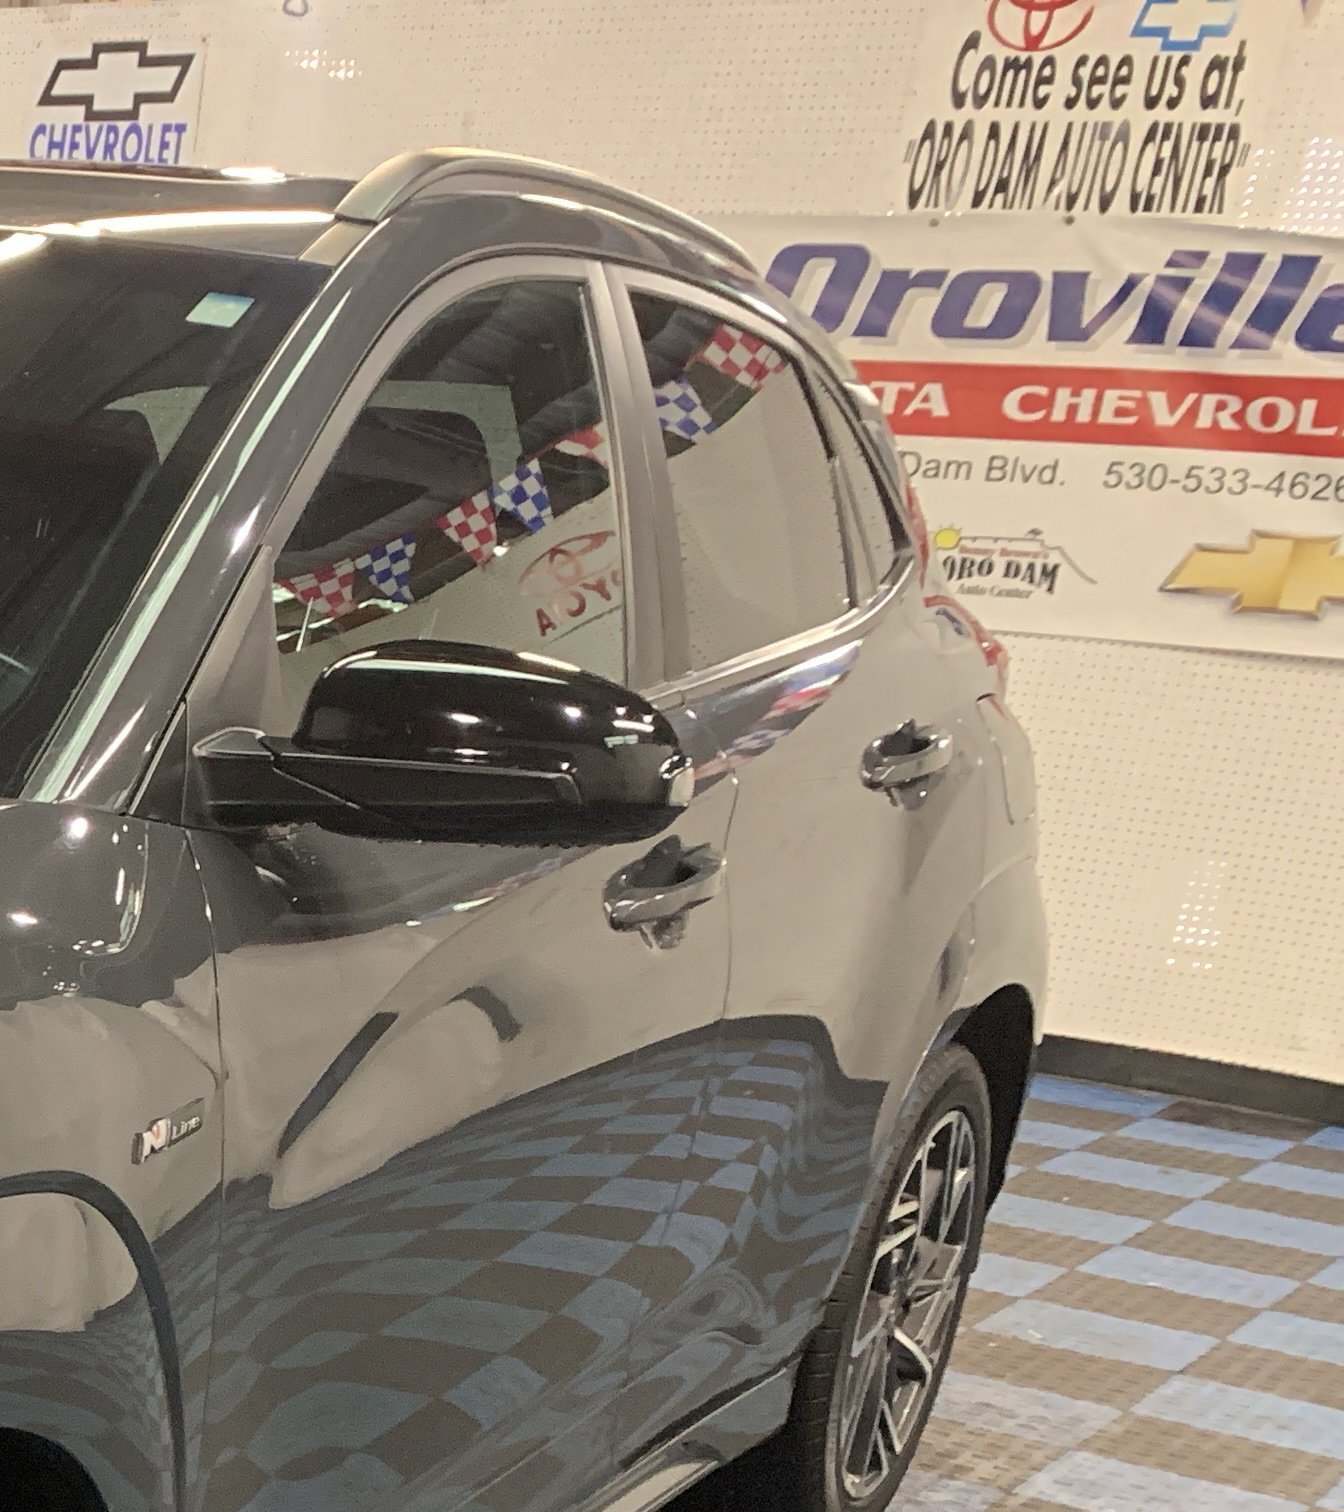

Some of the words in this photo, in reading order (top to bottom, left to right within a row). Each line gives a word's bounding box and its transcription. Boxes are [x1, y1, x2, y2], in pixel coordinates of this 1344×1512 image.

[951, 30, 1056, 111] Come
[1064, 54, 1134, 111] see
[1143, 54, 1191, 110] us
[1199, 40, 1247, 117] at,
[29, 123, 187, 164] CHEVROLET
[971, 121, 1050, 210] DAM
[1043, 120, 1131, 214] AUTO
[1003, 385, 1344, 437] CHEVROL
[898, 450, 972, 481] Dam
[984, 454, 1065, 486] Blvd.
[1002, 560, 1061, 594] DAM
